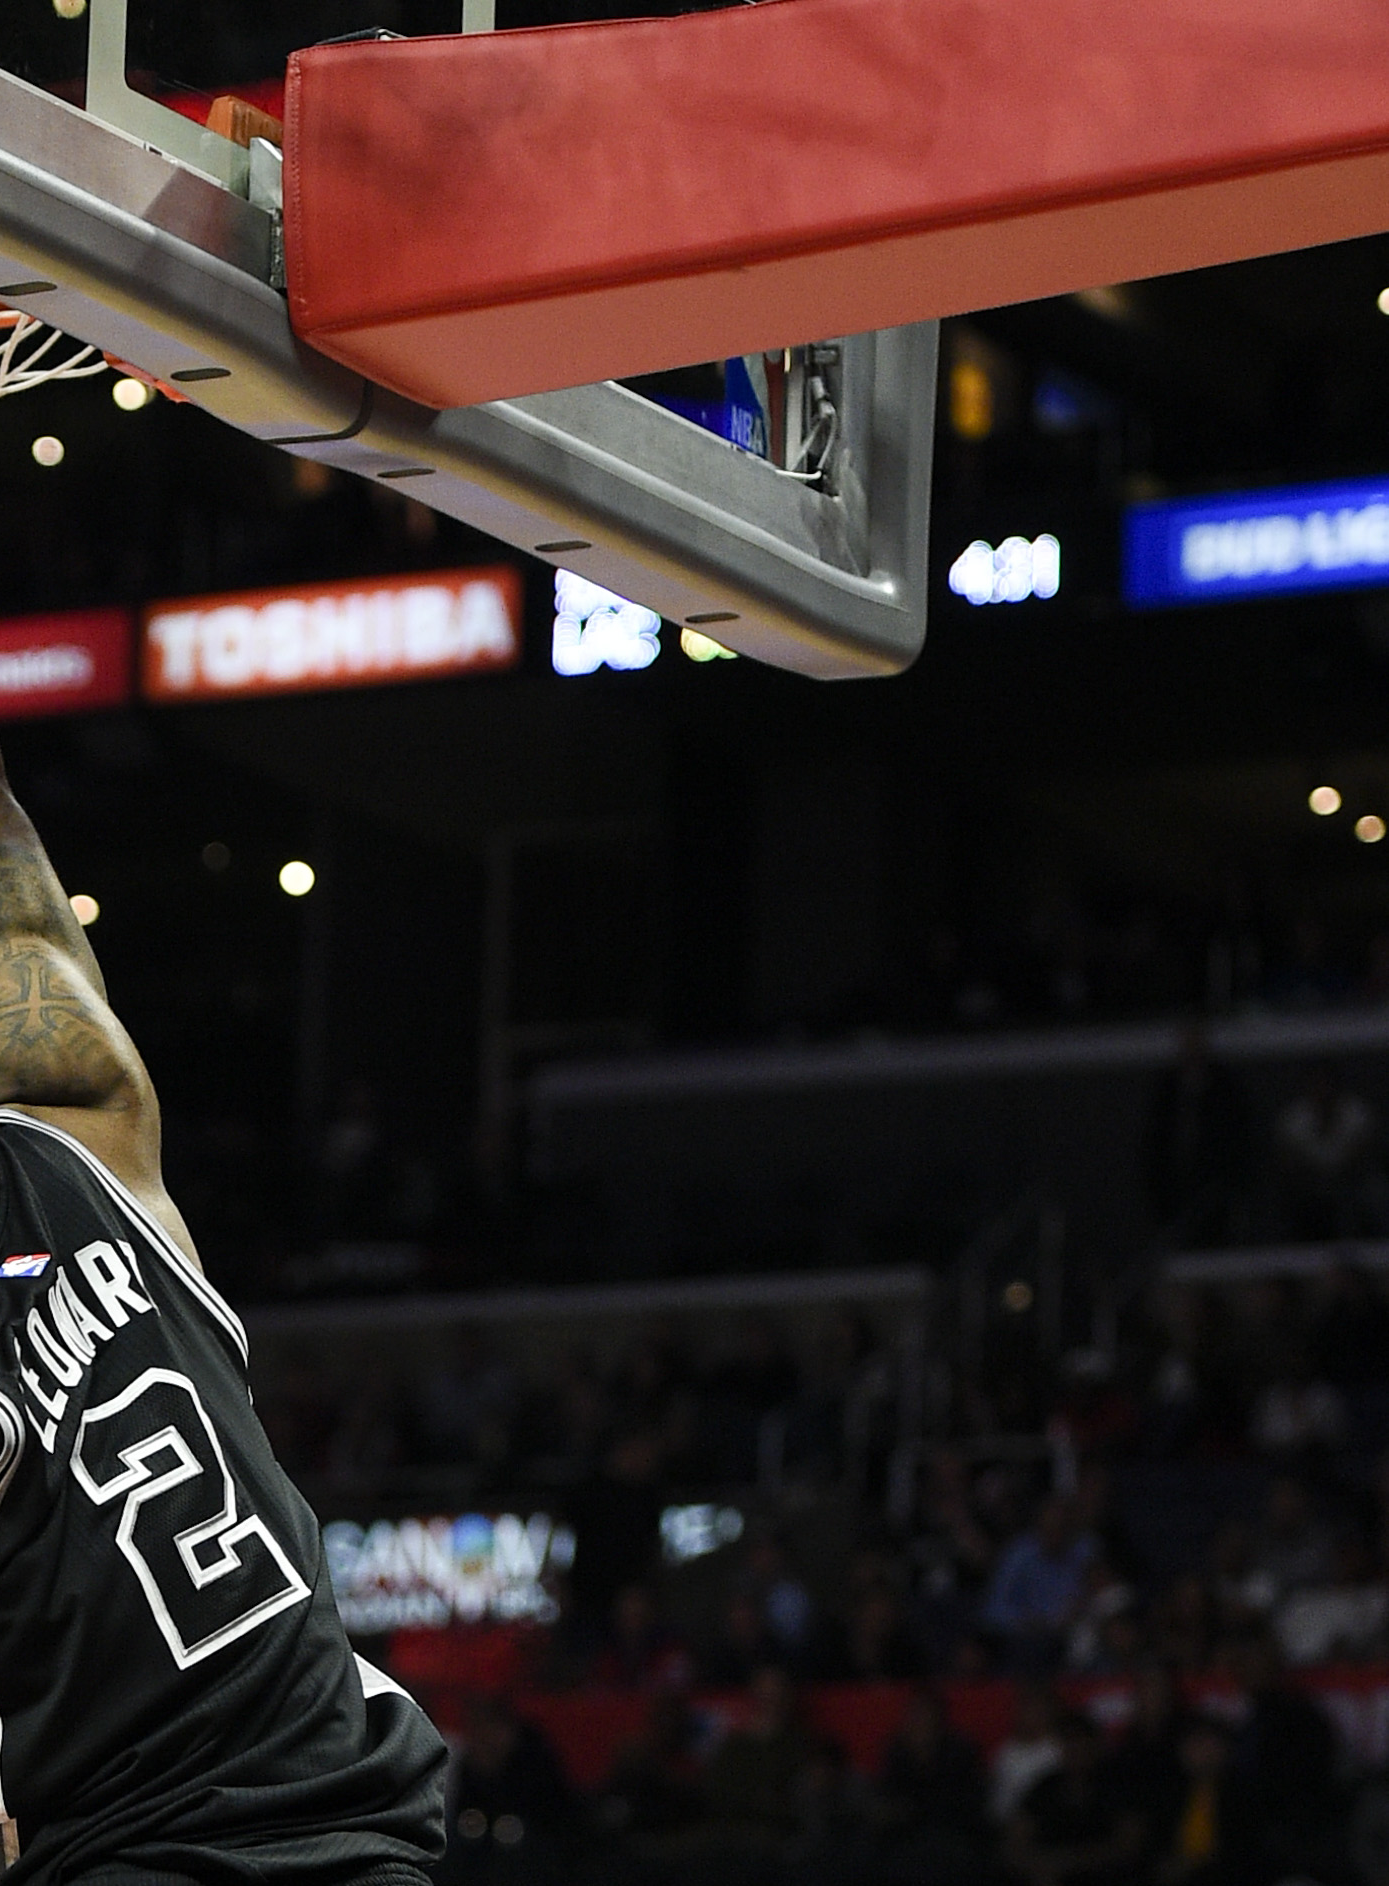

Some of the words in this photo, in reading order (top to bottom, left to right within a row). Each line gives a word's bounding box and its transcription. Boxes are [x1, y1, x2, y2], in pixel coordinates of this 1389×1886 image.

[147, 581, 516, 690] TOSHIBA
[13, 1238, 162, 1454] LEONAR
[69, 1366, 312, 1671] 2
